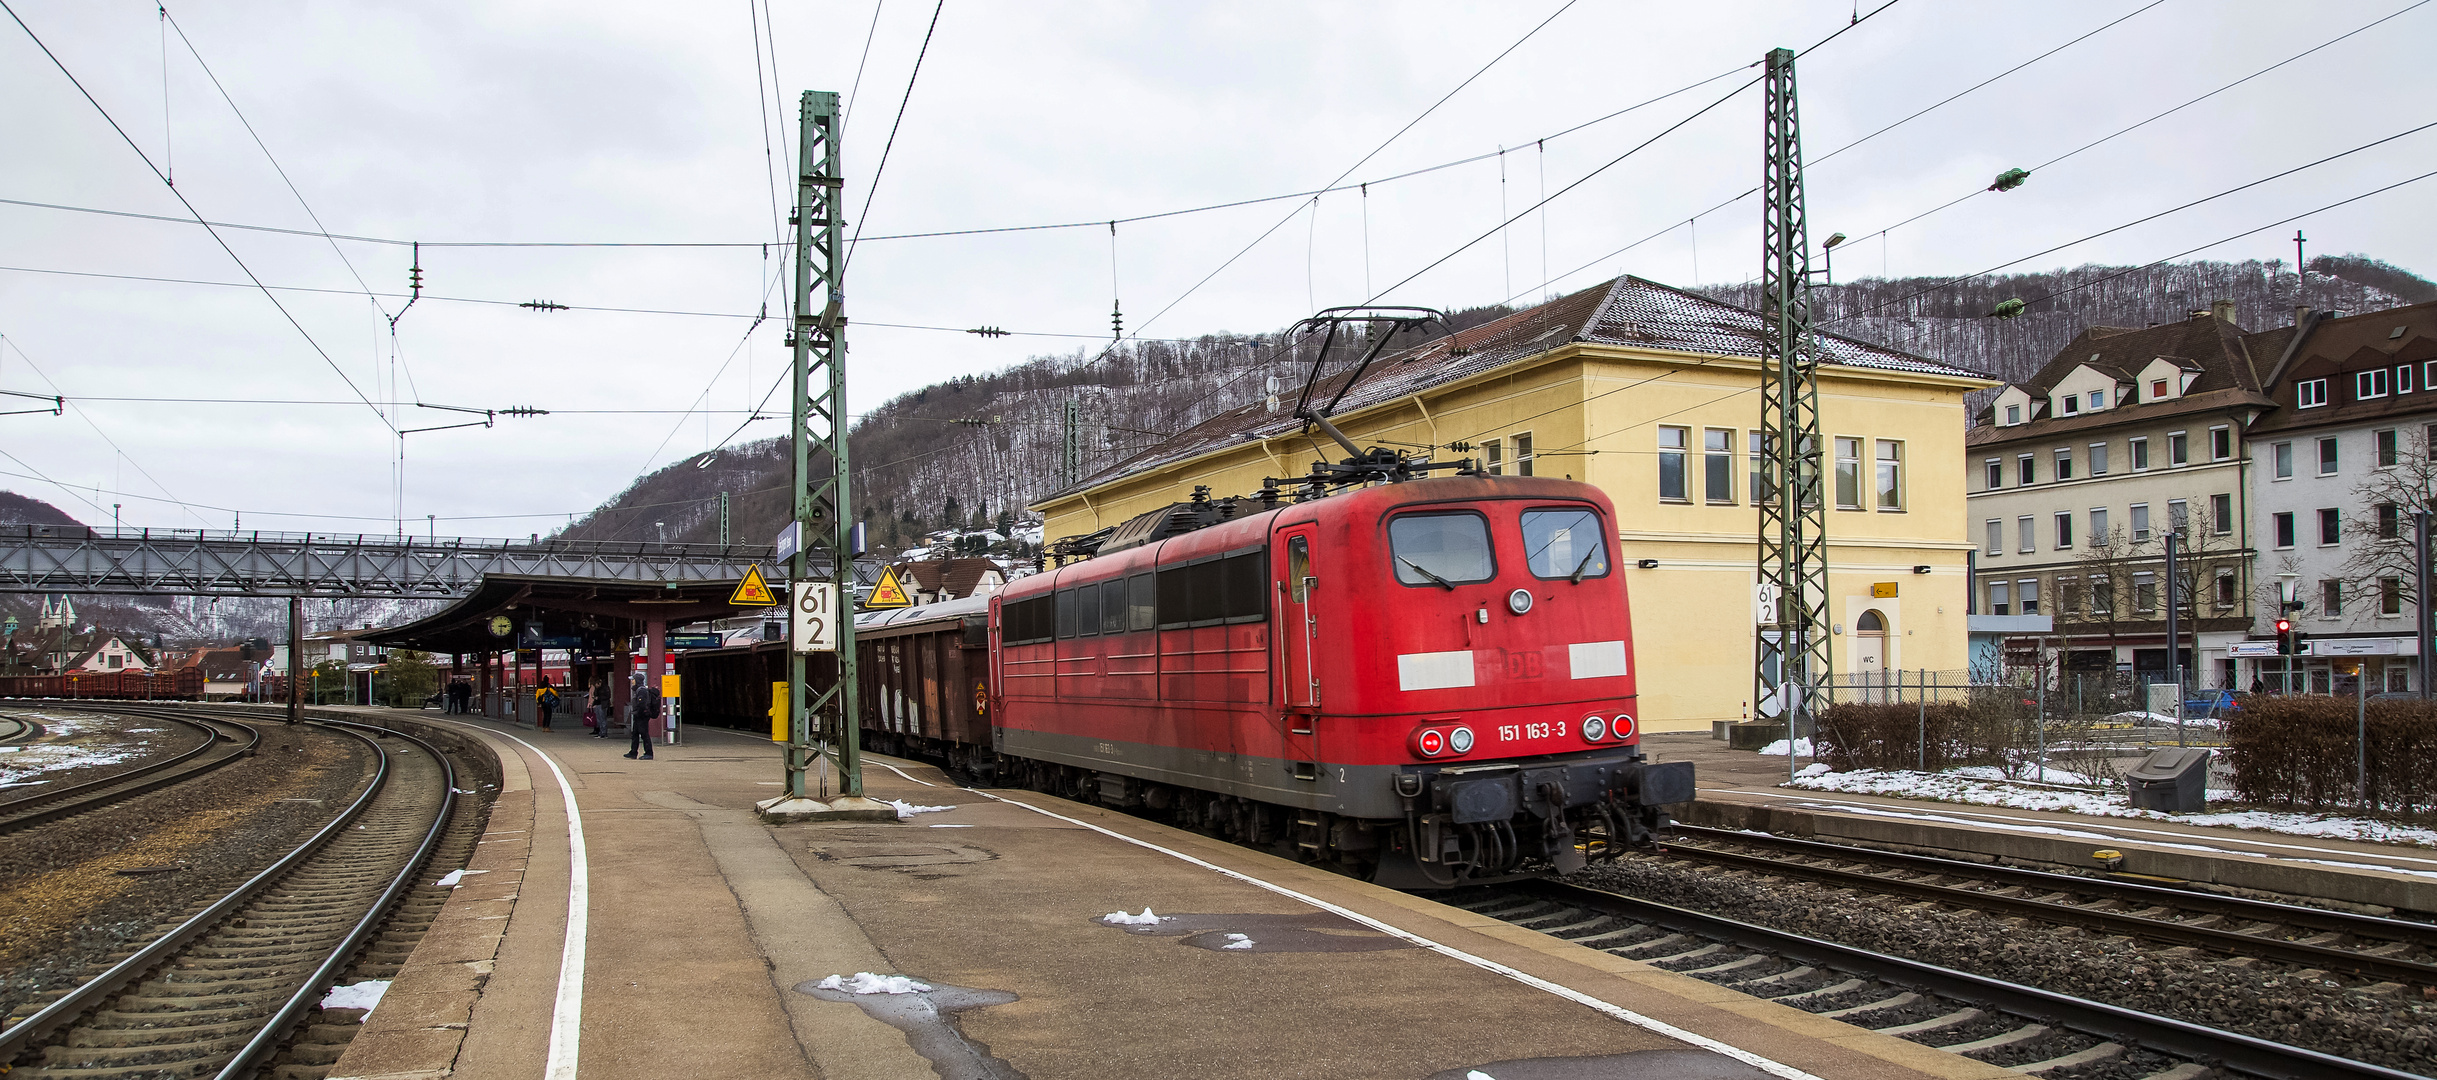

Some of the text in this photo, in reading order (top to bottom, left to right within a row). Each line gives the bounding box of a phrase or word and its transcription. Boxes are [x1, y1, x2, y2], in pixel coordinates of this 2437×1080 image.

[799, 586, 827, 614] 61
[1759, 585, 1772, 603] 61
[1763, 605, 1772, 621] 2
[807, 617, 824, 645] 2
[592, 639, 596, 647] 1
[714, 636, 719, 644] 2
[471, 652, 478, 662] 3
[1508, 652, 1541, 679] DB
[1498, 721, 1567, 742] 151 163-3
[1339, 767, 1345, 783] 2
